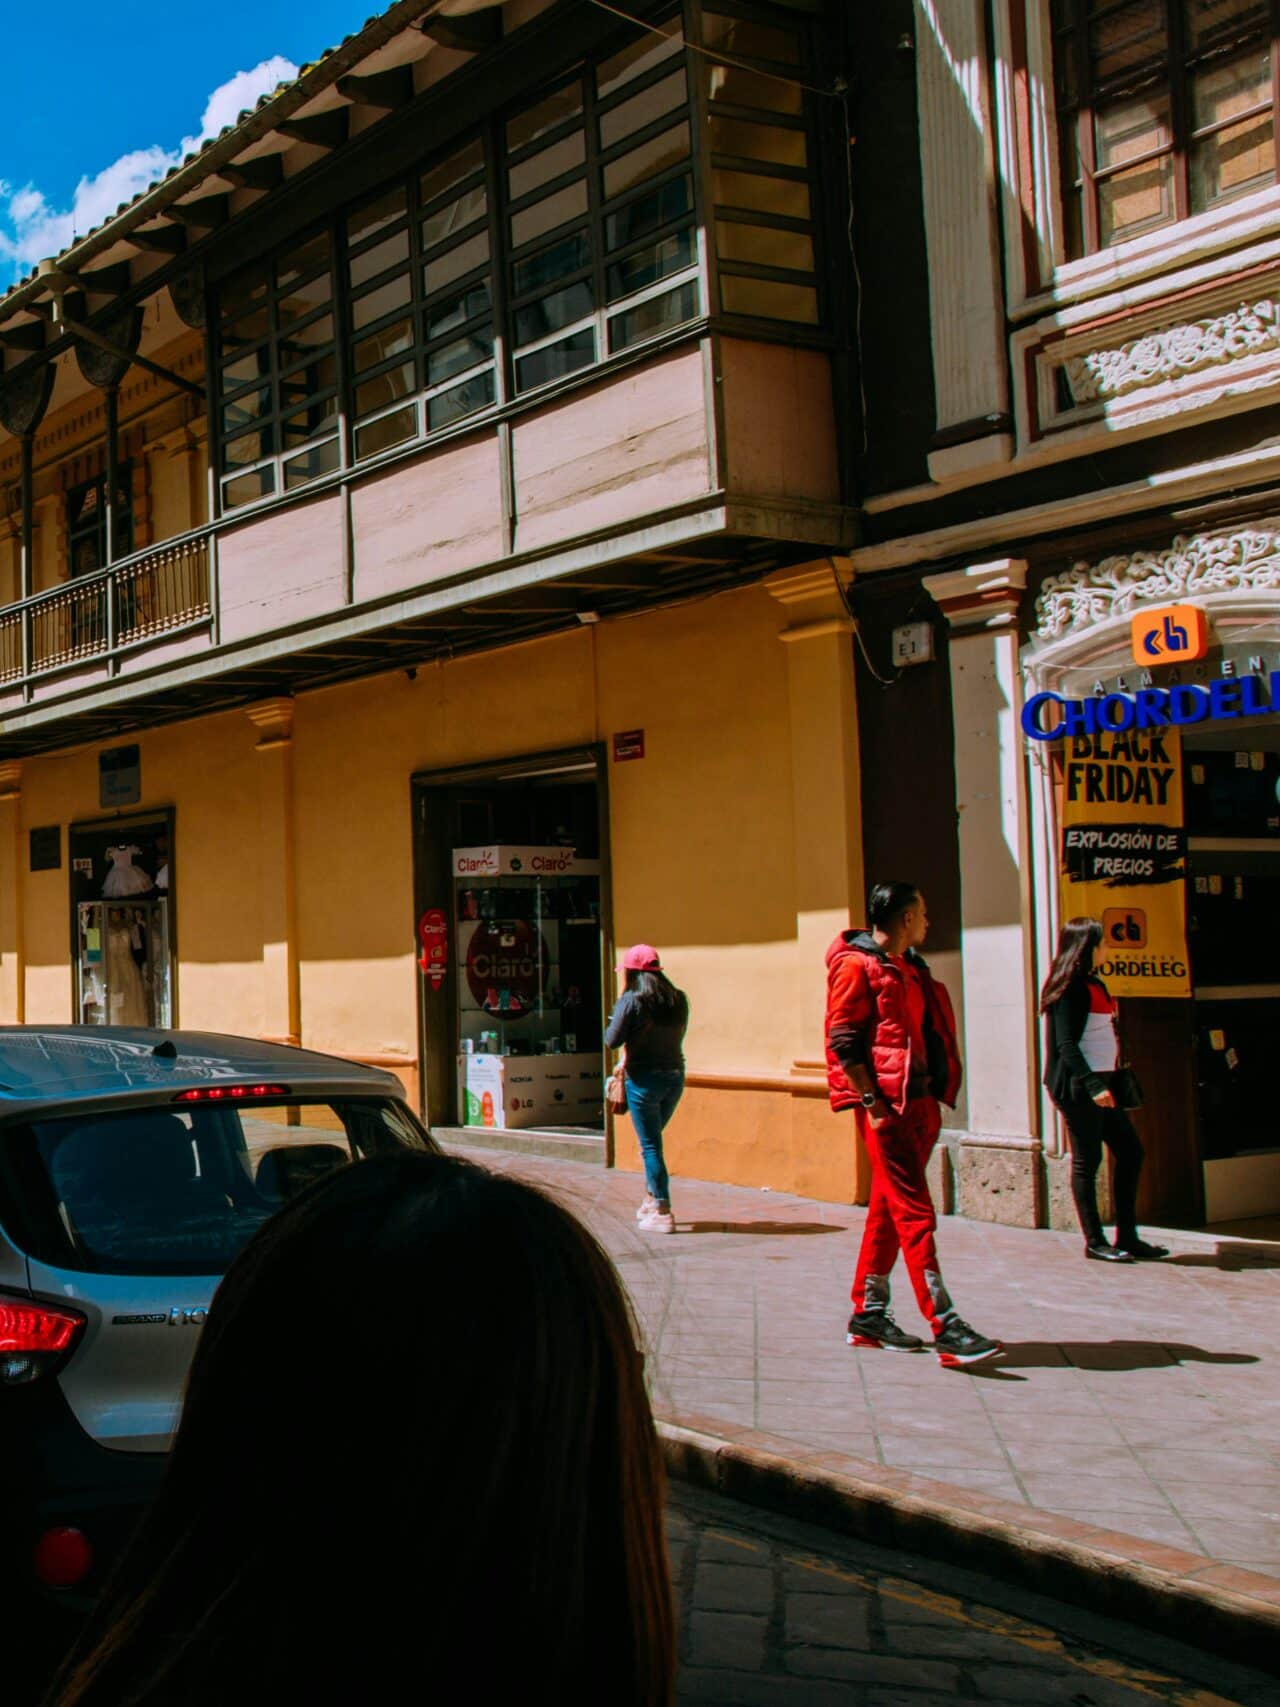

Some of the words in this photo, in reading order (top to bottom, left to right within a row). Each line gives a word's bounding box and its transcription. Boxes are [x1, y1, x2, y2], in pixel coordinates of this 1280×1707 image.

[1093, 652, 1280, 693] ALMACEN
[1071, 735, 1171, 763] BLACK
[1067, 763, 1175, 805] FRIDAY
[1065, 828, 1153, 850] EXPLOSIÓN
[1155, 833, 1179, 851] DE
[531, 855, 568, 871] Claro
[1092, 855, 1155, 876] PRECIOS
[472, 954, 535, 978] Claro
[1095, 960, 1186, 977] ORDELEG
